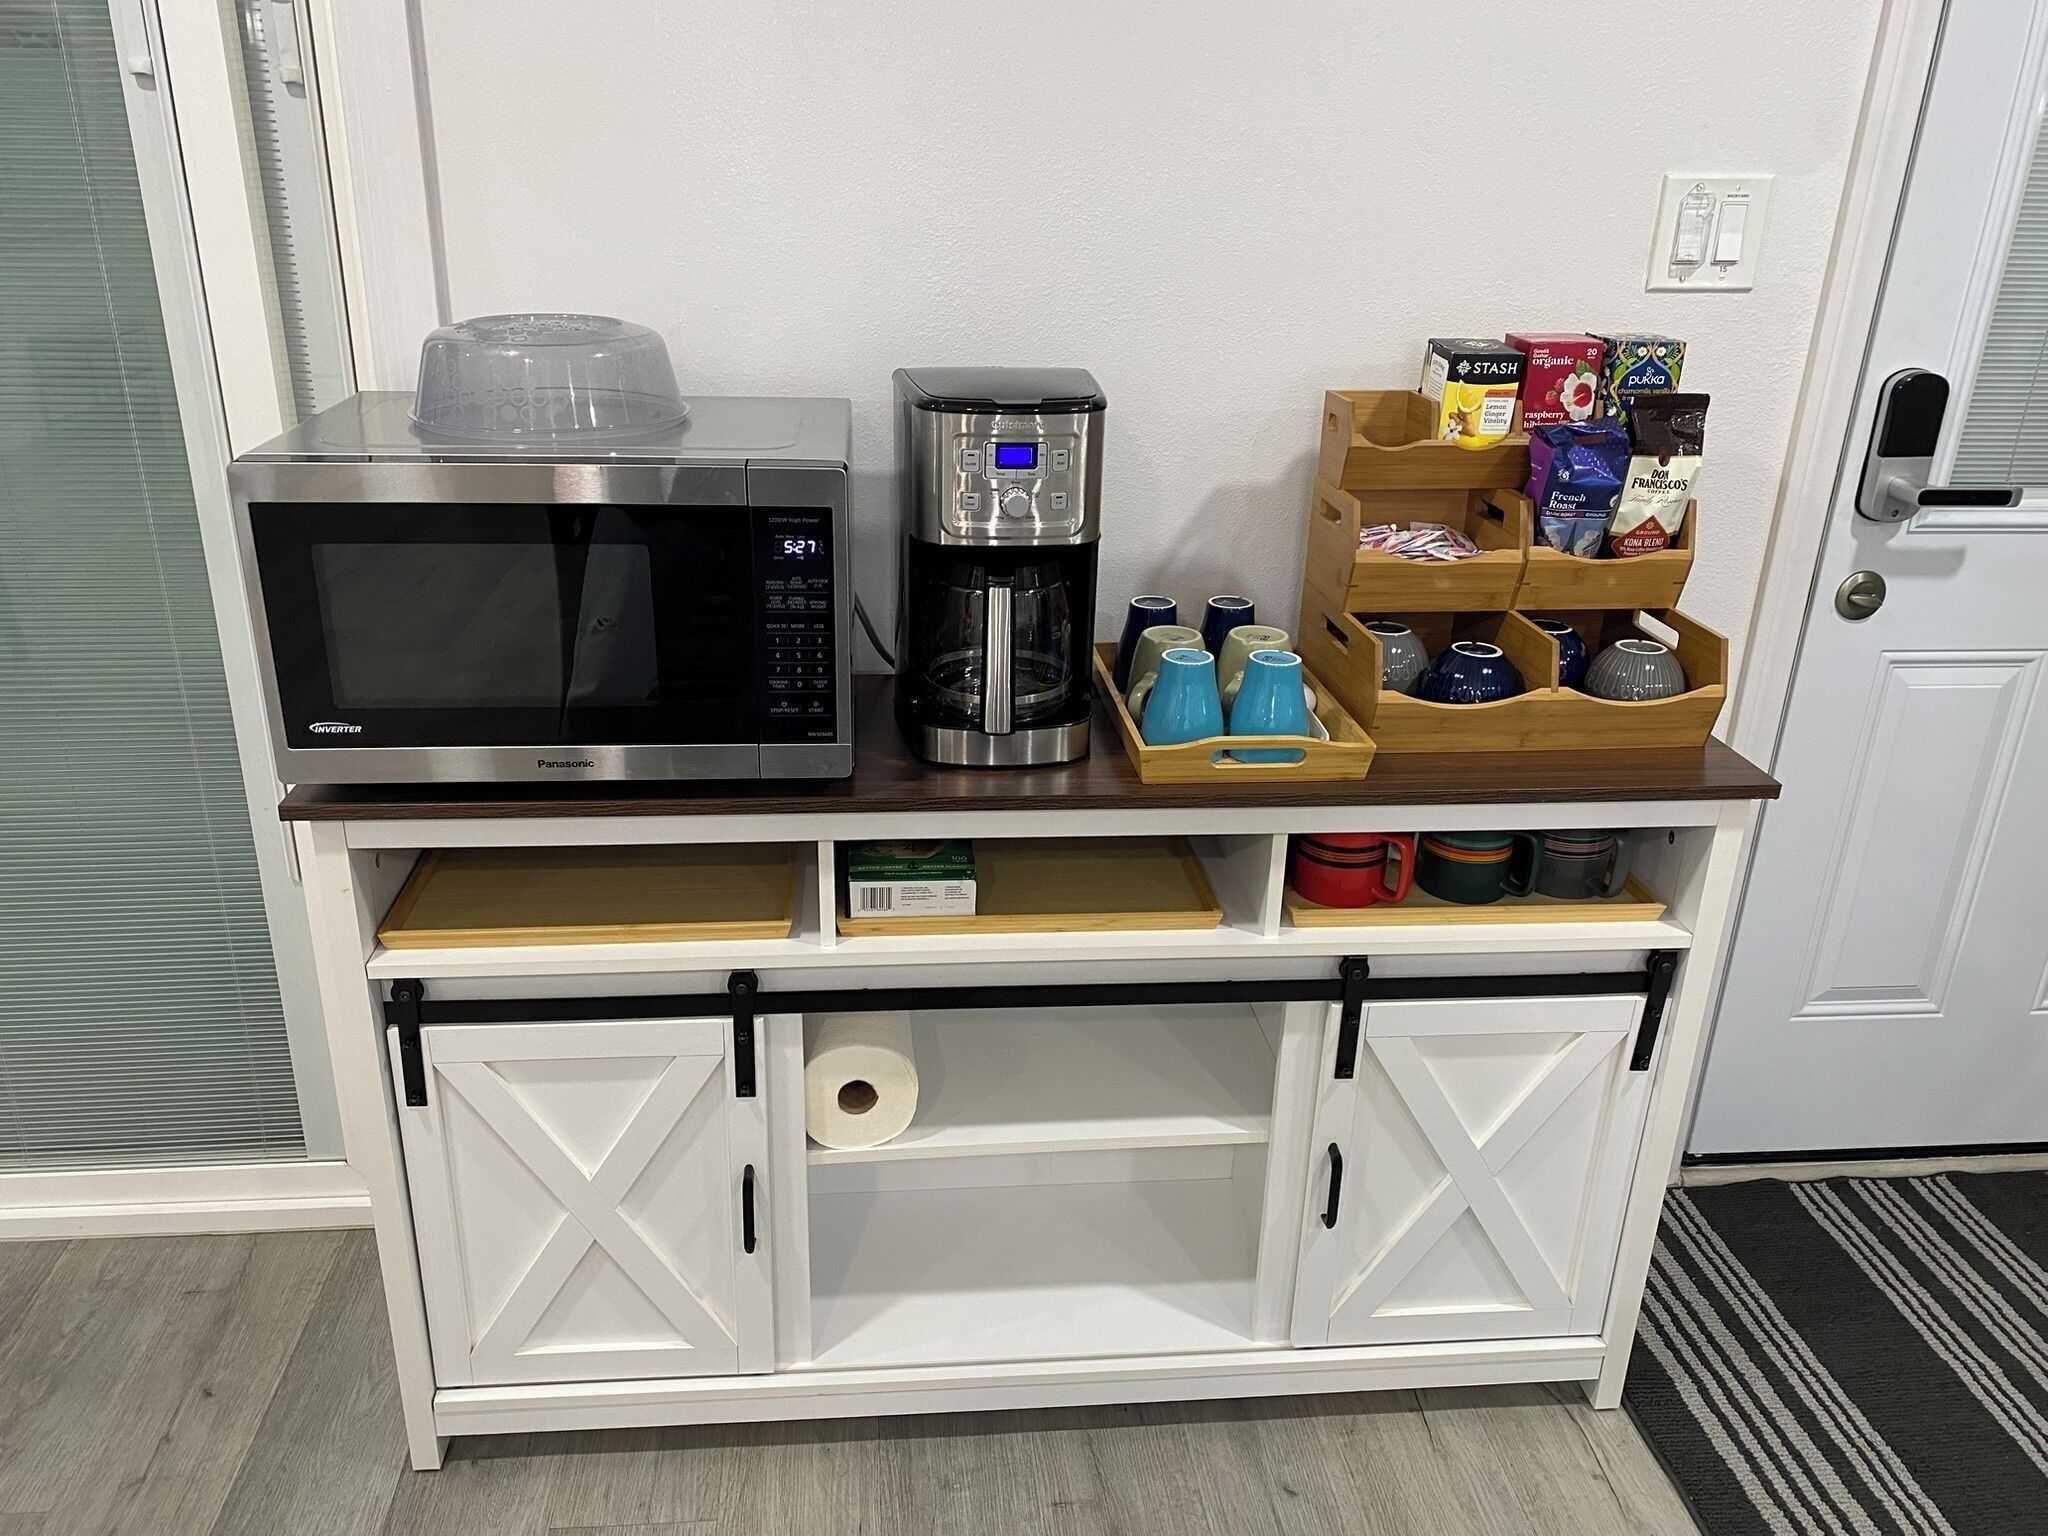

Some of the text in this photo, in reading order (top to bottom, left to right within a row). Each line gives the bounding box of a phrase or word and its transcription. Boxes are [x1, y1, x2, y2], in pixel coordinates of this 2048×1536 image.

[1586, 348, 1598, 356] 20
[1473, 362, 1518, 374] STASH
[1532, 356, 1574, 369] organic
[1628, 371, 1665, 387] pukka
[1484, 410, 1507, 418] Ginger
[1524, 410, 1565, 420] raspberry
[1483, 417, 1508, 425] Vitality
[1651, 469, 1670, 480] DON
[1631, 477, 1688, 491] FRANCISCO'S
[1551, 490, 1586, 502] French
[1548, 499, 1577, 510] Roast
[784, 540, 816, 554] 5:27
[1623, 537, 1665, 547] KONA BLEND
[314, 724, 362, 733] INVERTER
[537, 759, 595, 768] Panasonic
